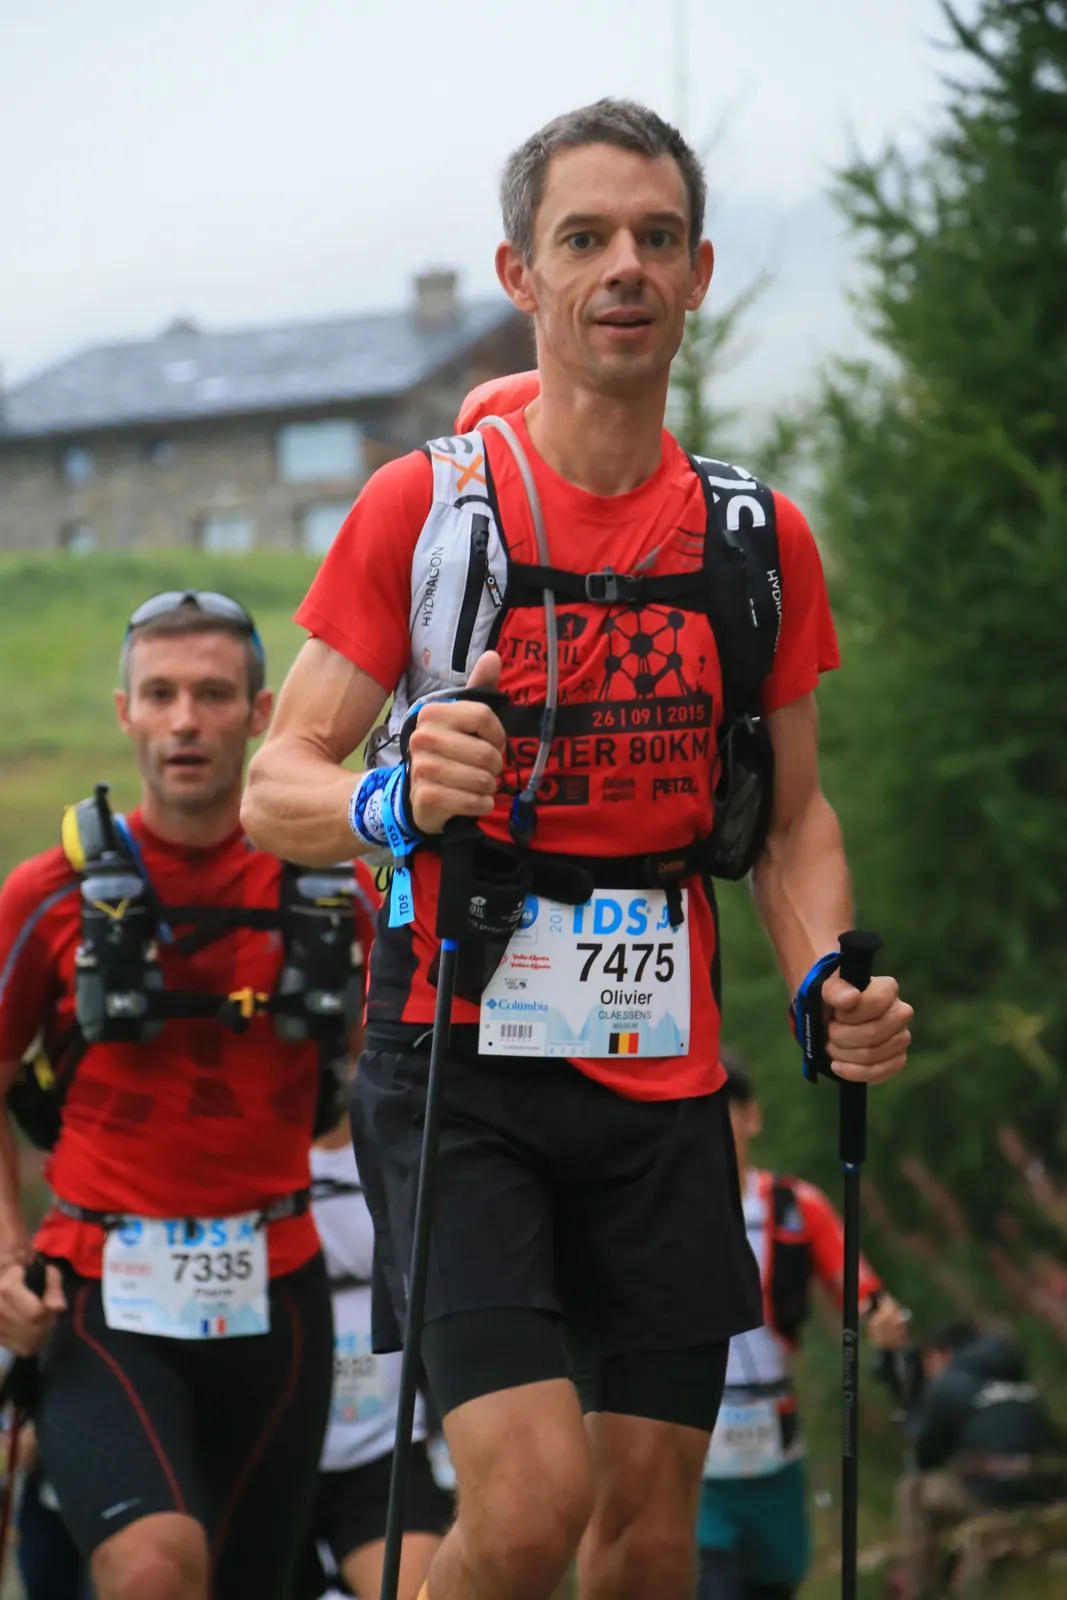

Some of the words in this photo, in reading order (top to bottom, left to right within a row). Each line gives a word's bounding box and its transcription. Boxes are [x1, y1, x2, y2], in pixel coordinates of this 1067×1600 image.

[422, 546, 445, 627] HYDRAGON
[506, 737, 616, 769] ISHER
[629, 732, 711, 765] 80KM
[388, 825, 402, 848] TDS
[400, 894, 409, 916] TDS
[573, 897, 648, 937] TDS
[549, 907, 563, 934] 201
[576, 943, 675, 983] 7475
[498, 999, 548, 1012] Columbia
[600, 989, 653, 1005] Olivier
[598, 1010, 652, 1020] CLAESSENS
[163, 1218, 229, 1247] TDS
[171, 1249, 254, 1284] 7335
